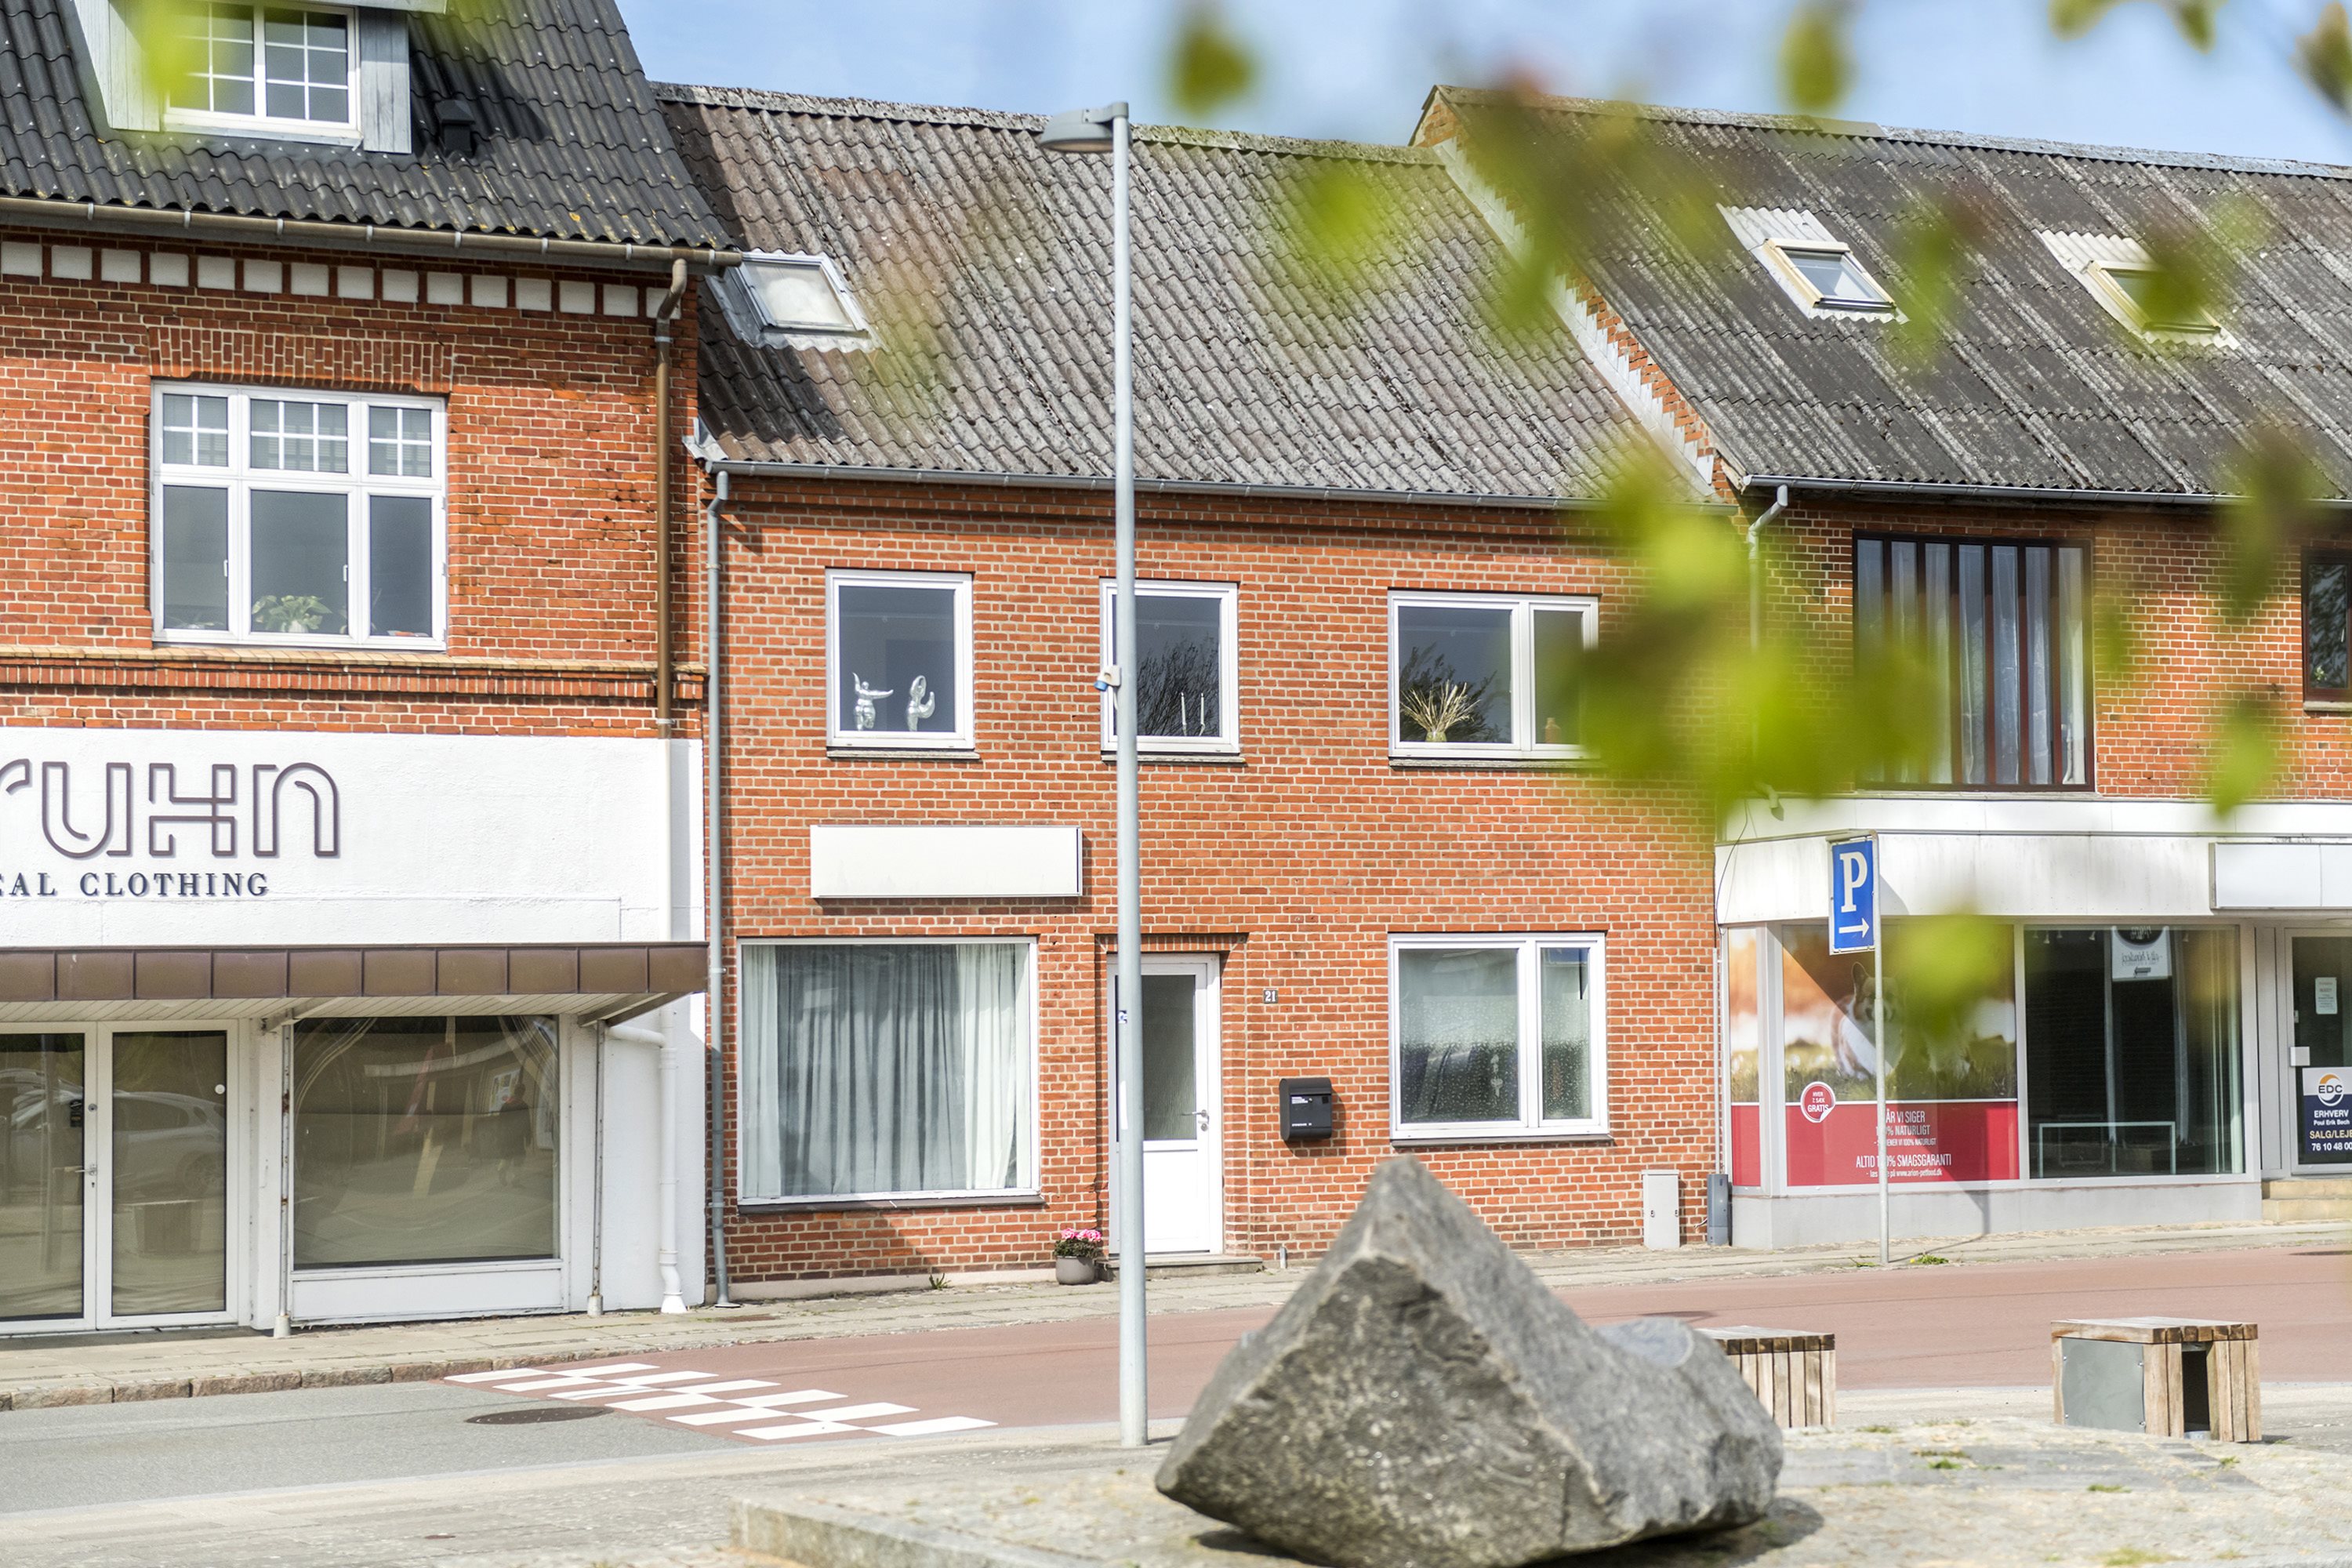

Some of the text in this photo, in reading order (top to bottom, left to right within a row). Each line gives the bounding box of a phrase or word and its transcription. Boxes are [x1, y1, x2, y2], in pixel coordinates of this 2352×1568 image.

[0, 872, 269, 897] AL CLOTHING
[1839, 851, 1868, 913] P
[1265, 990, 1276, 1002] 21
[2318, 1085, 2343, 1094] EDC
[1886, 1109, 1926, 1123] ÅR VI SIGER
[2314, 1109, 2349, 1118] ERHVERV
[1895, 1125, 1930, 1136] NATURLIGT
[1856, 1155, 1875, 1167] ALTID
[1896, 1154, 1951, 1167] SMAGSGARANTI
